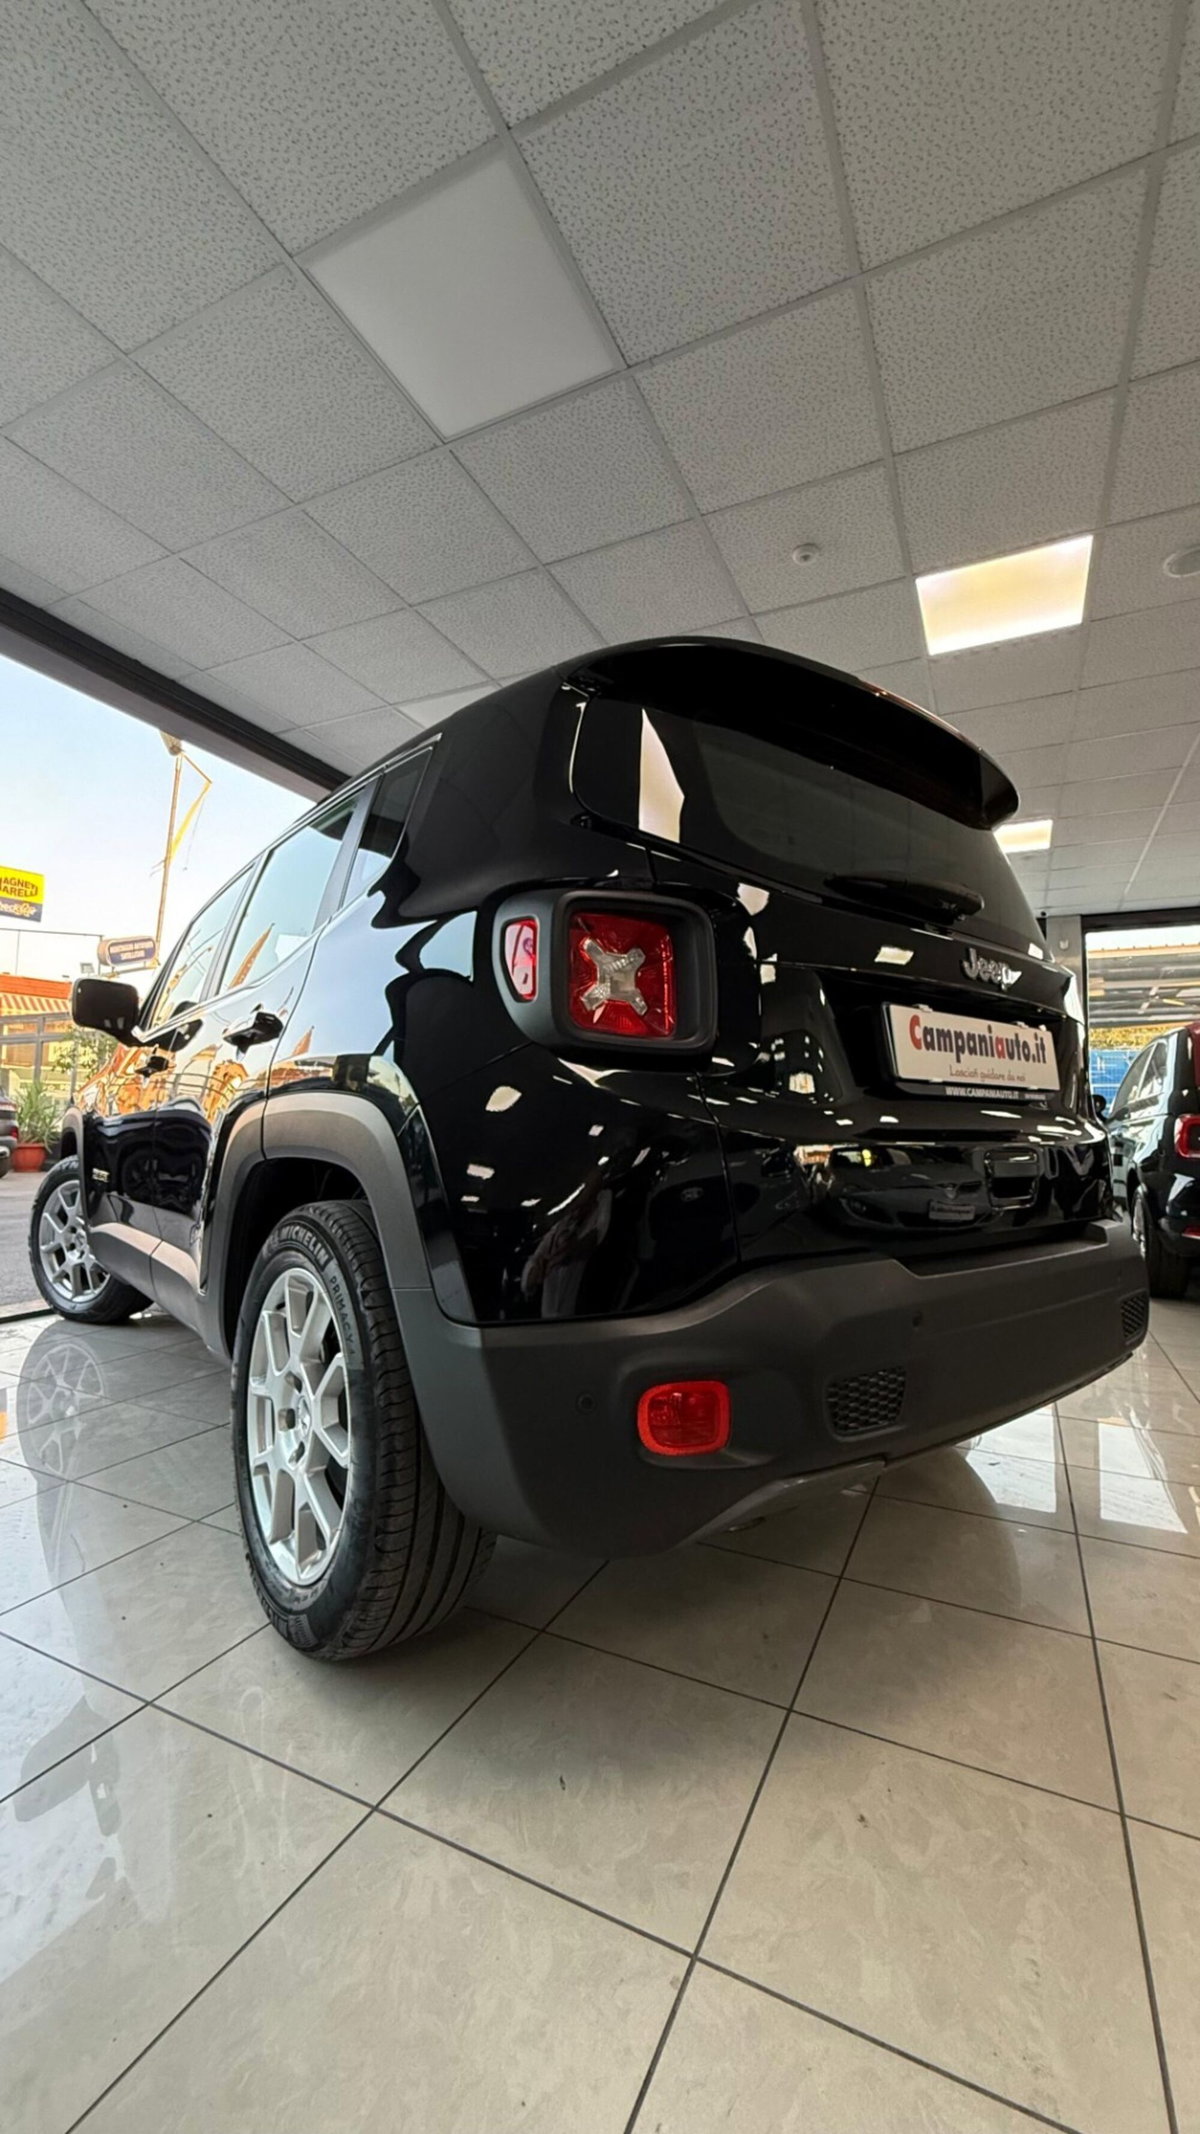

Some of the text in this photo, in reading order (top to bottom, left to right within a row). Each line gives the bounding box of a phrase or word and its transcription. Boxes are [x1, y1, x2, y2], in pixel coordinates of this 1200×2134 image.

[962, 947, 1022, 991] Jeep
[909, 1014, 1047, 1064] Campaniauto.it
[1007, 1068, 1015, 1081] da
[280, 1225, 329, 1267] MICHELIN
[330, 1275, 354, 1343] PRIMACY
